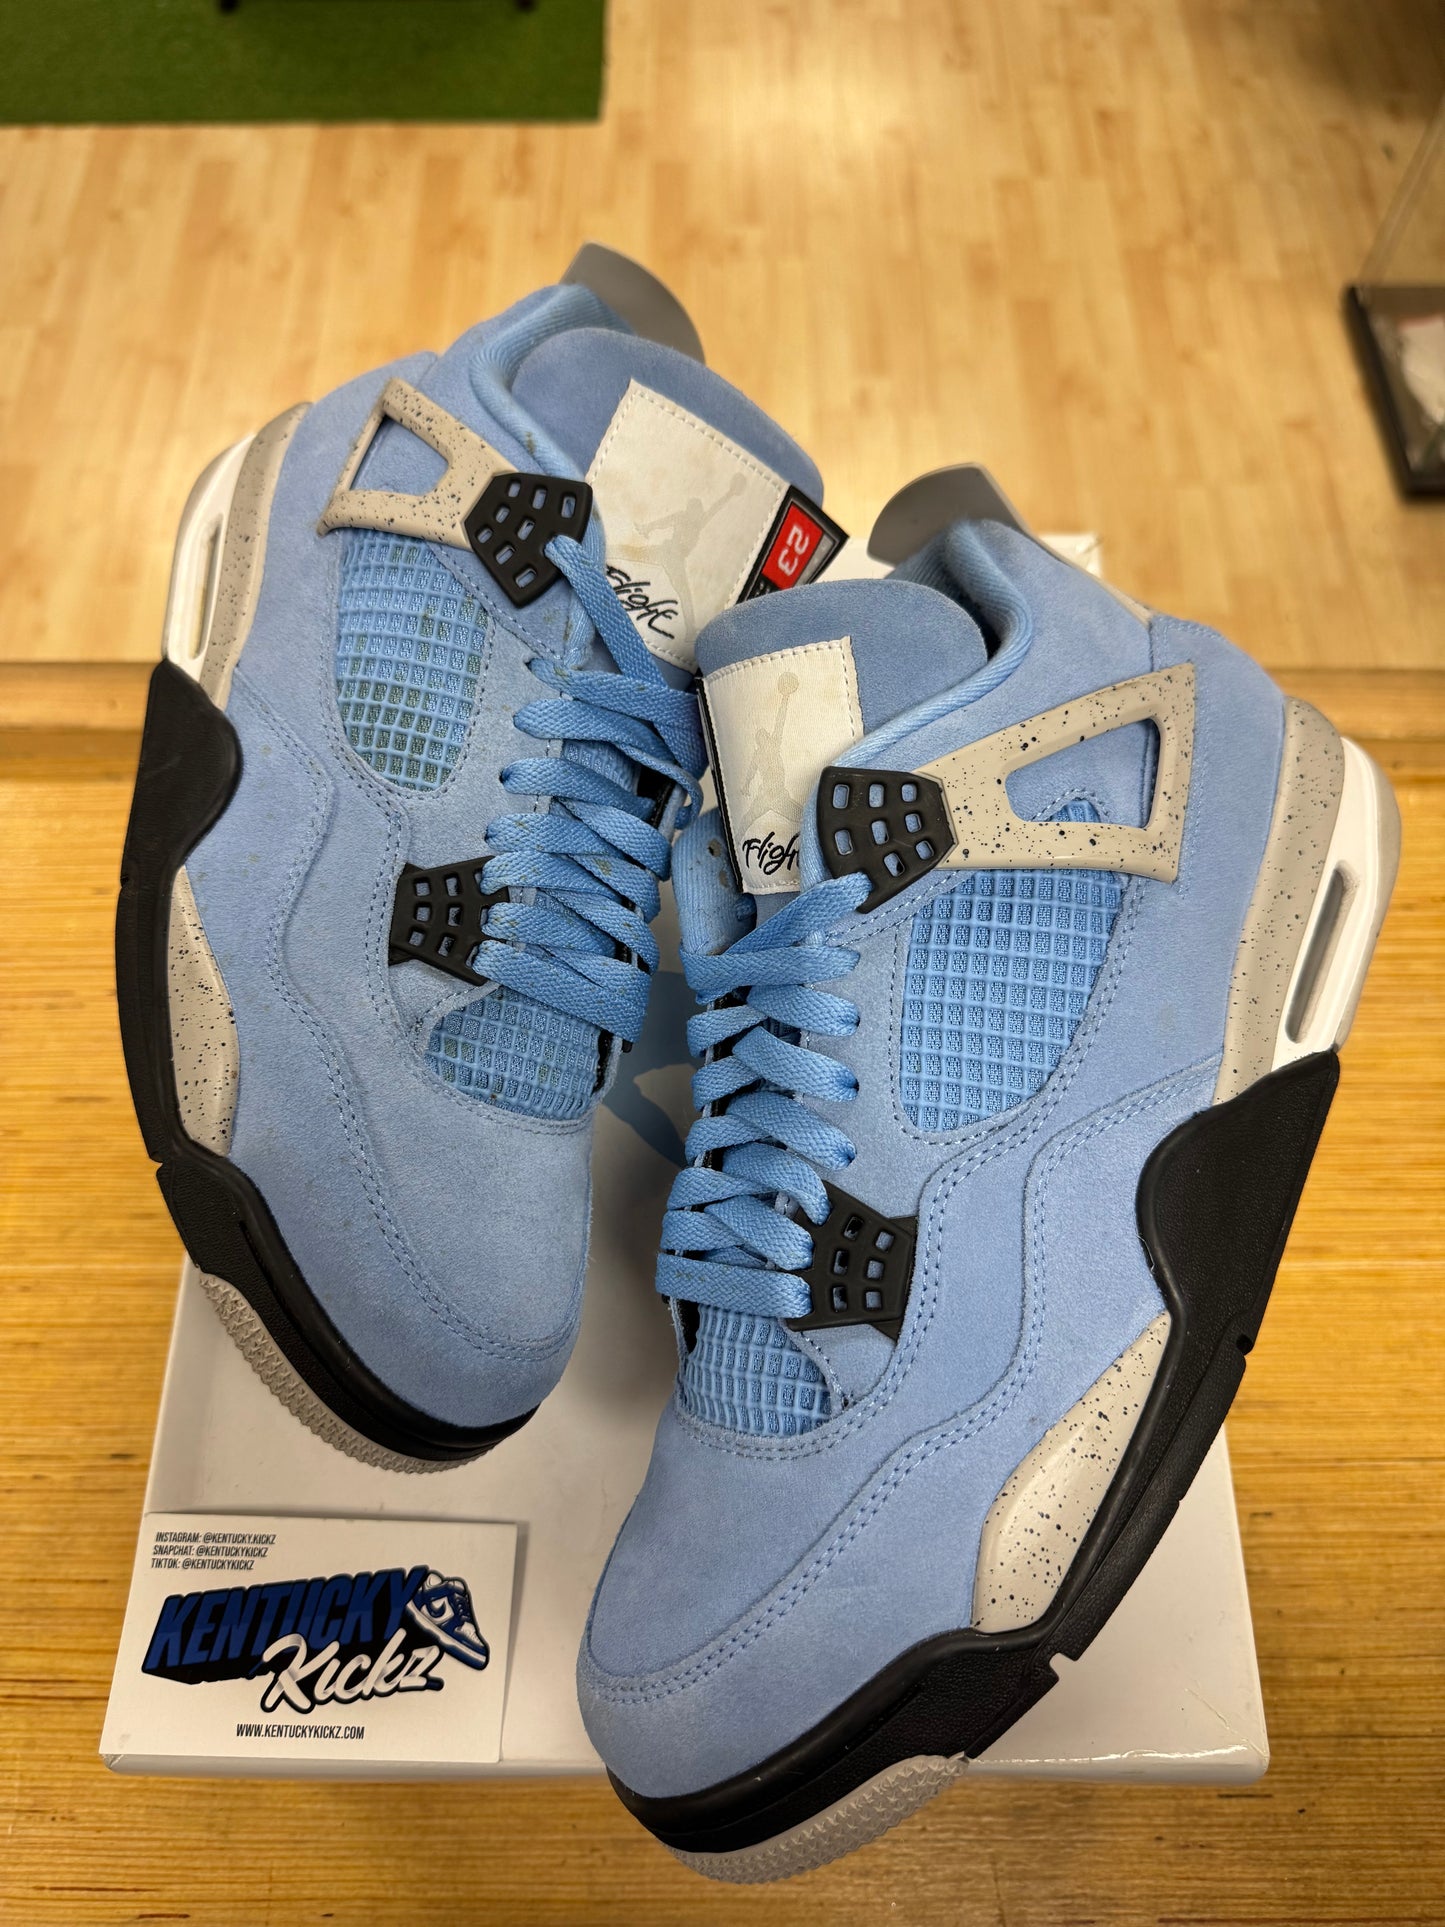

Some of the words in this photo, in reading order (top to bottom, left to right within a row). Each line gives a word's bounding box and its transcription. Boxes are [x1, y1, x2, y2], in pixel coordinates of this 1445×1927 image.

[777, 523, 811, 577] 23
[742, 831, 800, 876] Fligh
[153, 1544, 195, 1556] SNAPCHAT:
[196, 1545, 269, 1558] @KENTUCKYKICKZ
[155, 1531, 202, 1543] INSTAGRAM:
[203, 1532, 277, 1545] @KENTUCKY.KICKZ
[150, 1557, 181, 1569] TIKTOK:
[182, 1557, 255, 1571] @KENTUCKYKICKZ
[143, 1566, 428, 1673] KENTUCKY
[260, 1627, 441, 1711] Kickz
[236, 1723, 366, 1740] WWW.KENTUCKYKICKZ.COM
